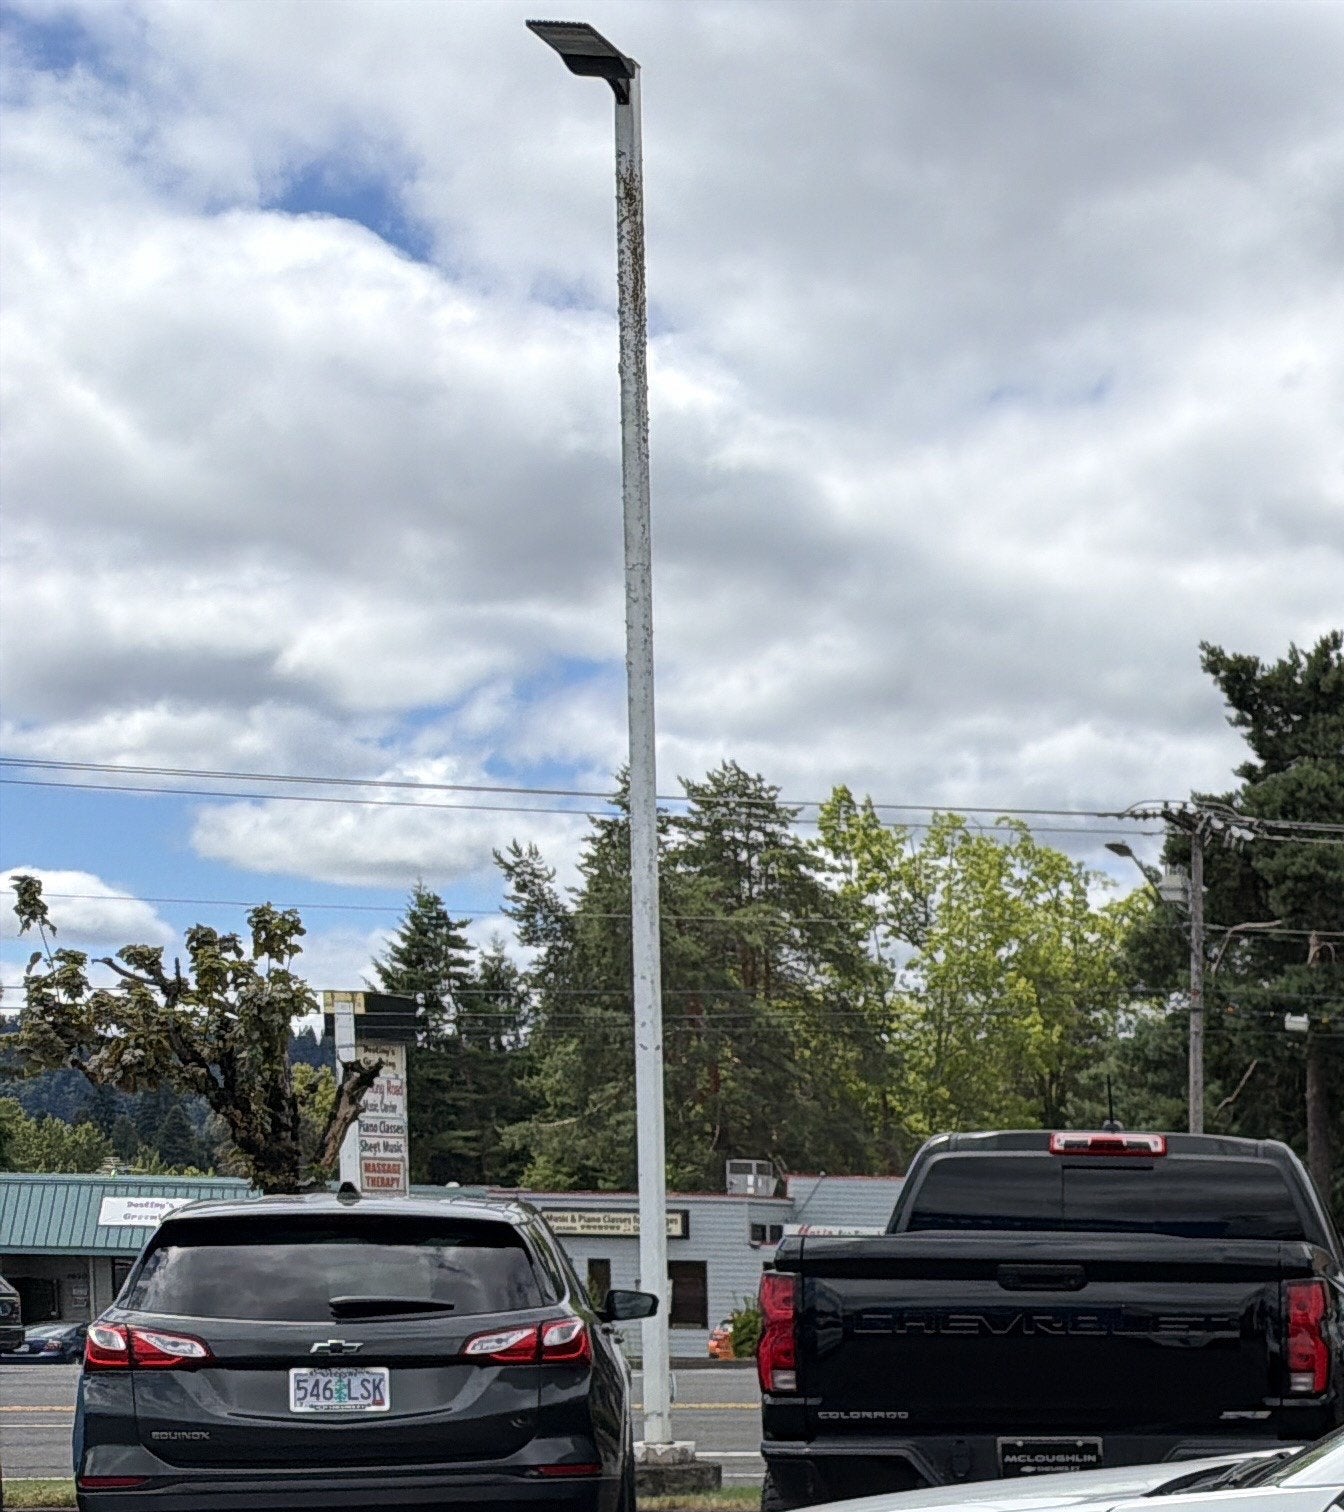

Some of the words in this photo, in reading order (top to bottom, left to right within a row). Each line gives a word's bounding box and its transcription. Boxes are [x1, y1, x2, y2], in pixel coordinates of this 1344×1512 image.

[380, 1120, 404, 1134] Classes
[383, 1140, 403, 1153] Music
[364, 1162, 401, 1174] MASSAGE
[365, 1175, 400, 1188] THERAPY
[853, 1312, 1240, 1337] CHEVROLET
[296, 1379, 334, 1401] 546
[347, 1378, 385, 1401] LSK
[817, 1411, 909, 1419] COLORADO
[151, 1431, 210, 1440] EQUINOX
